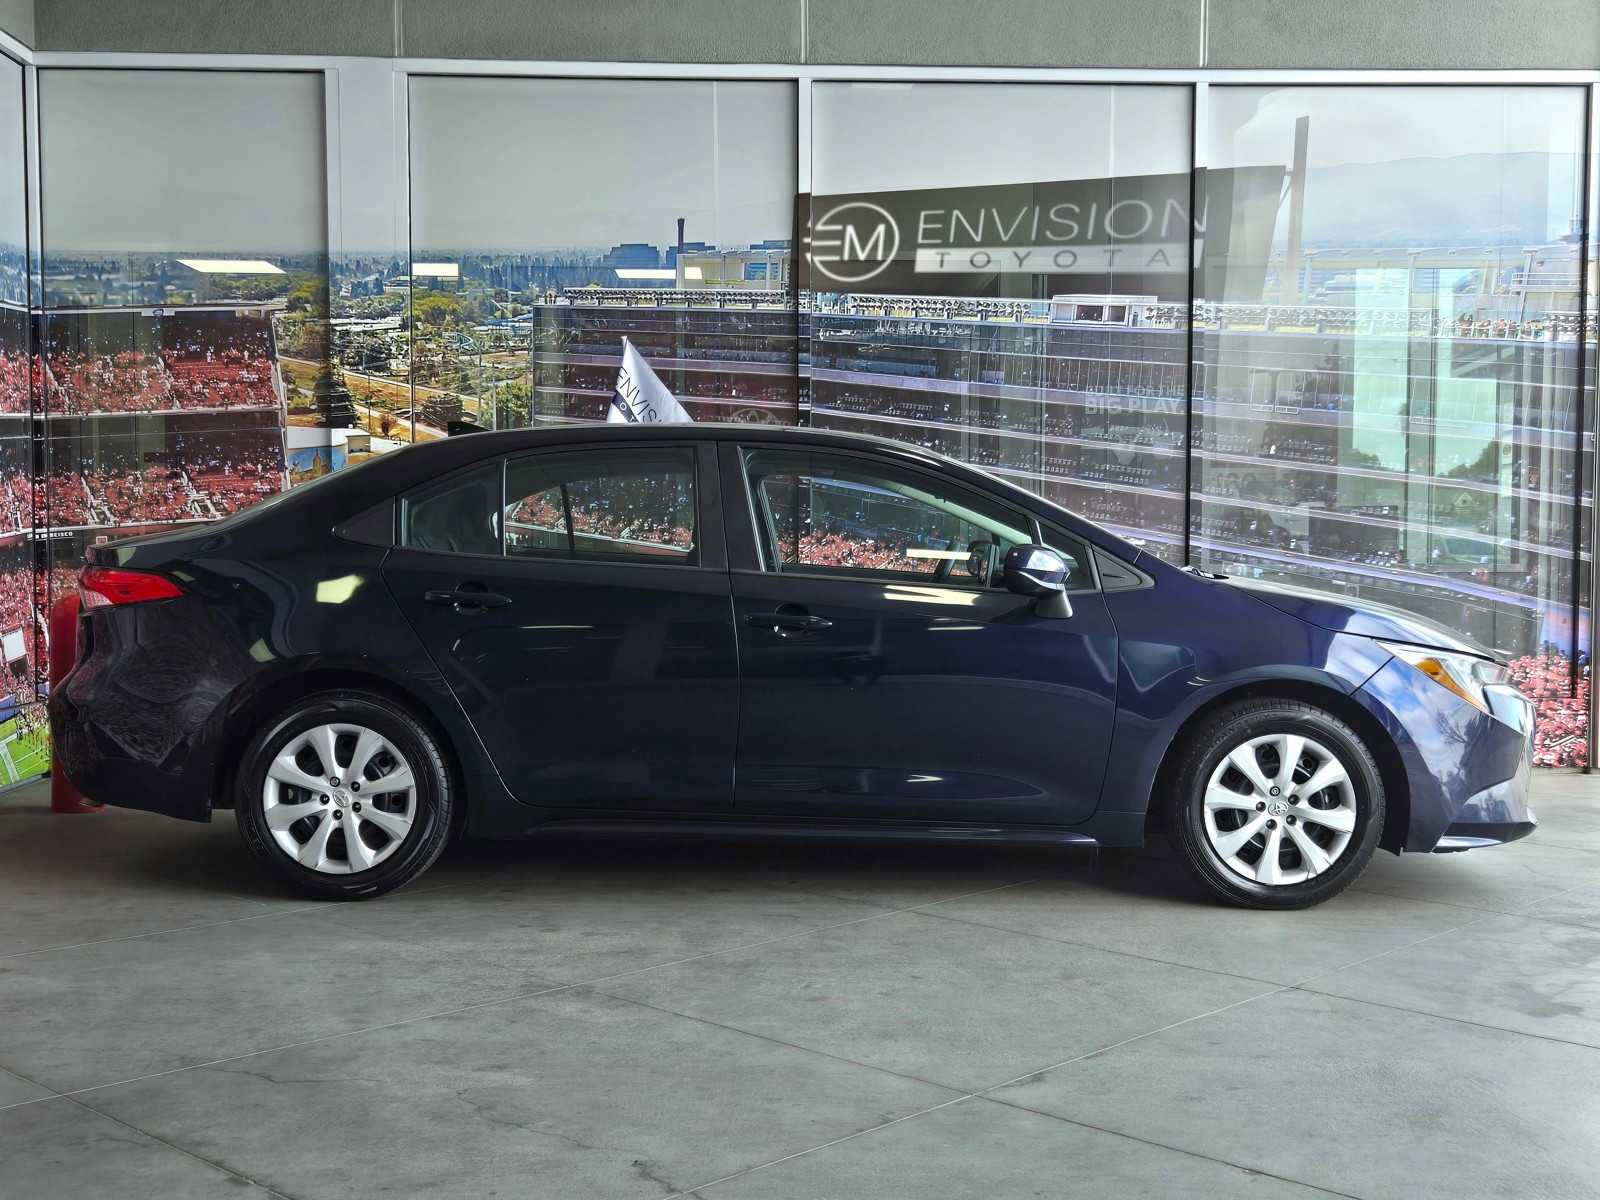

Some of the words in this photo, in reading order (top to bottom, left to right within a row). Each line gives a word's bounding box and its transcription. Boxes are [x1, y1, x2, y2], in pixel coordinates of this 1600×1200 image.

[917, 196, 1209, 244] ENVISION
[935, 247, 1171, 269] TOYOTA
[1085, 397, 1122, 415] BIG
